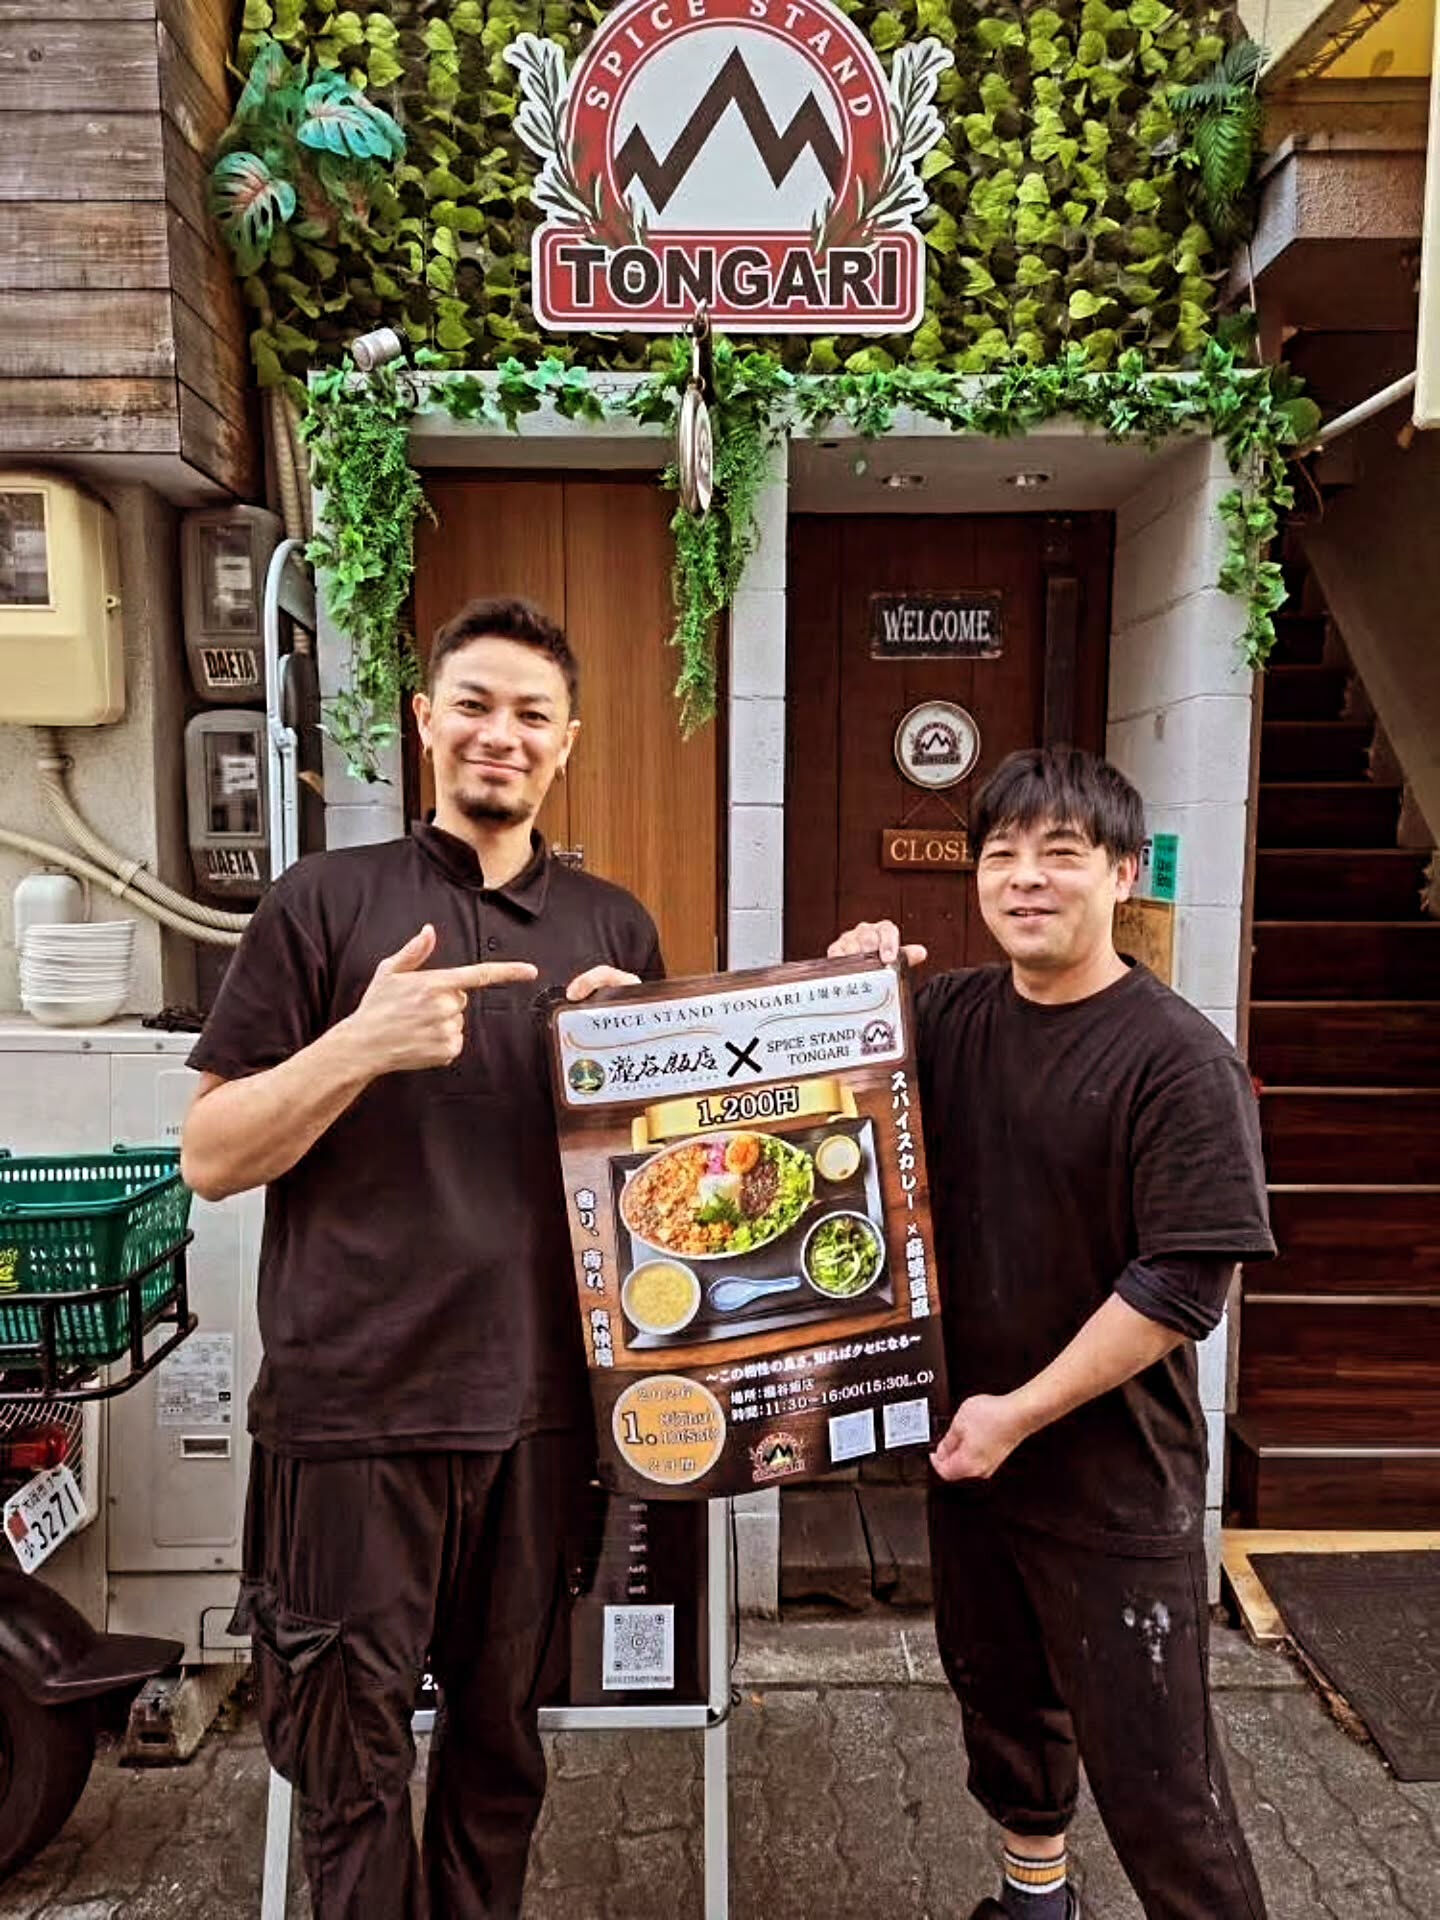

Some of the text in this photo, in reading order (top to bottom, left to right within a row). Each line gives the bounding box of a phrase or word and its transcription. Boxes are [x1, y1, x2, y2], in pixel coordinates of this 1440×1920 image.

[586, 0, 873, 117] SPICE STAND
[559, 247, 901, 310] TONGARI
[883, 605, 992, 643] WELCOME
[592, 1013, 646, 1031] SPICE
[653, 1006, 714, 1024] STAND
[719, 991, 801, 1015] TONGARI
[766, 1028, 857, 1054] SPICE STAND
[787, 1046, 850, 1066] TONGARI
[30, 1482, 80, 1550] 3271
